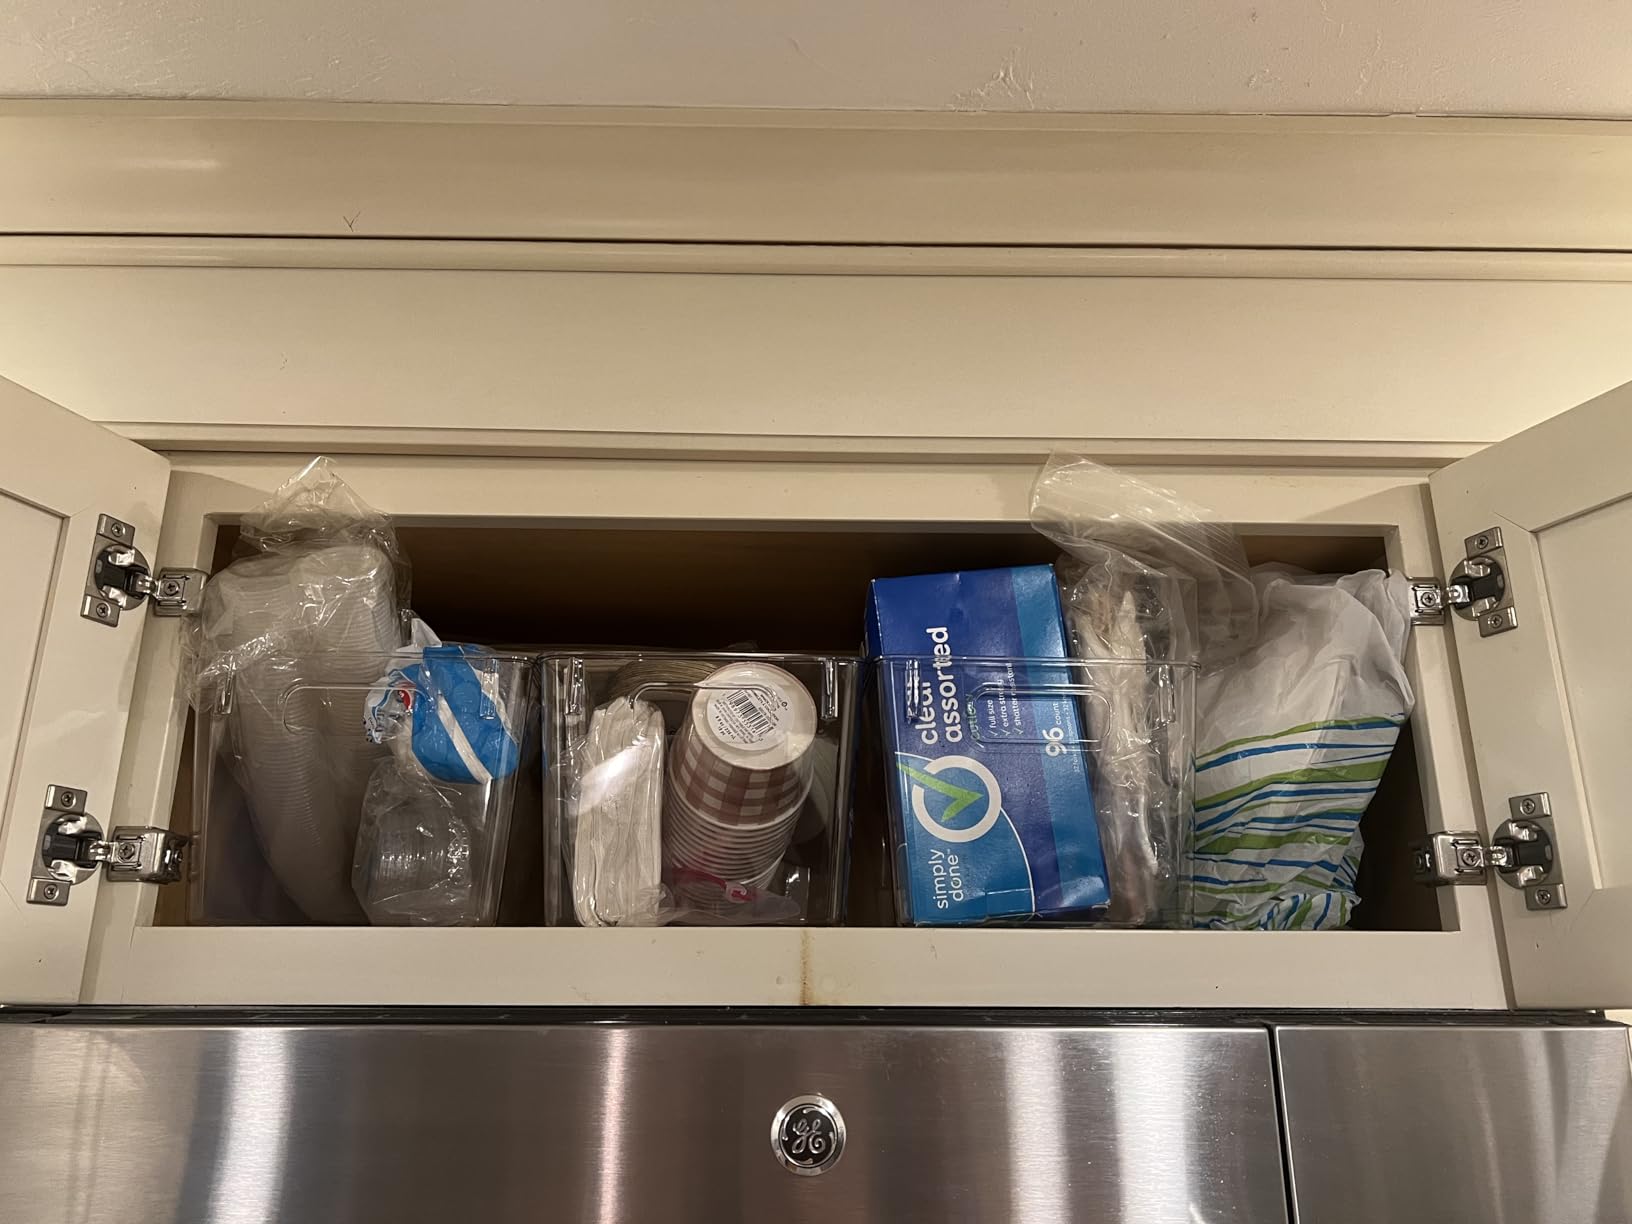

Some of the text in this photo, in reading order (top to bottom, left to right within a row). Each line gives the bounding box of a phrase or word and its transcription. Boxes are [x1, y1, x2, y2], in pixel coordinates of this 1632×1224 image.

[926, 627, 962, 742] assorted
[986, 699, 997, 728] full size
[1001, 706, 1009, 727] extra
[1011, 698, 1021, 726] shatter
[1042, 702, 1067, 757] 96 count
[928, 849, 948, 909] simply
[947, 855, 964, 901] done
